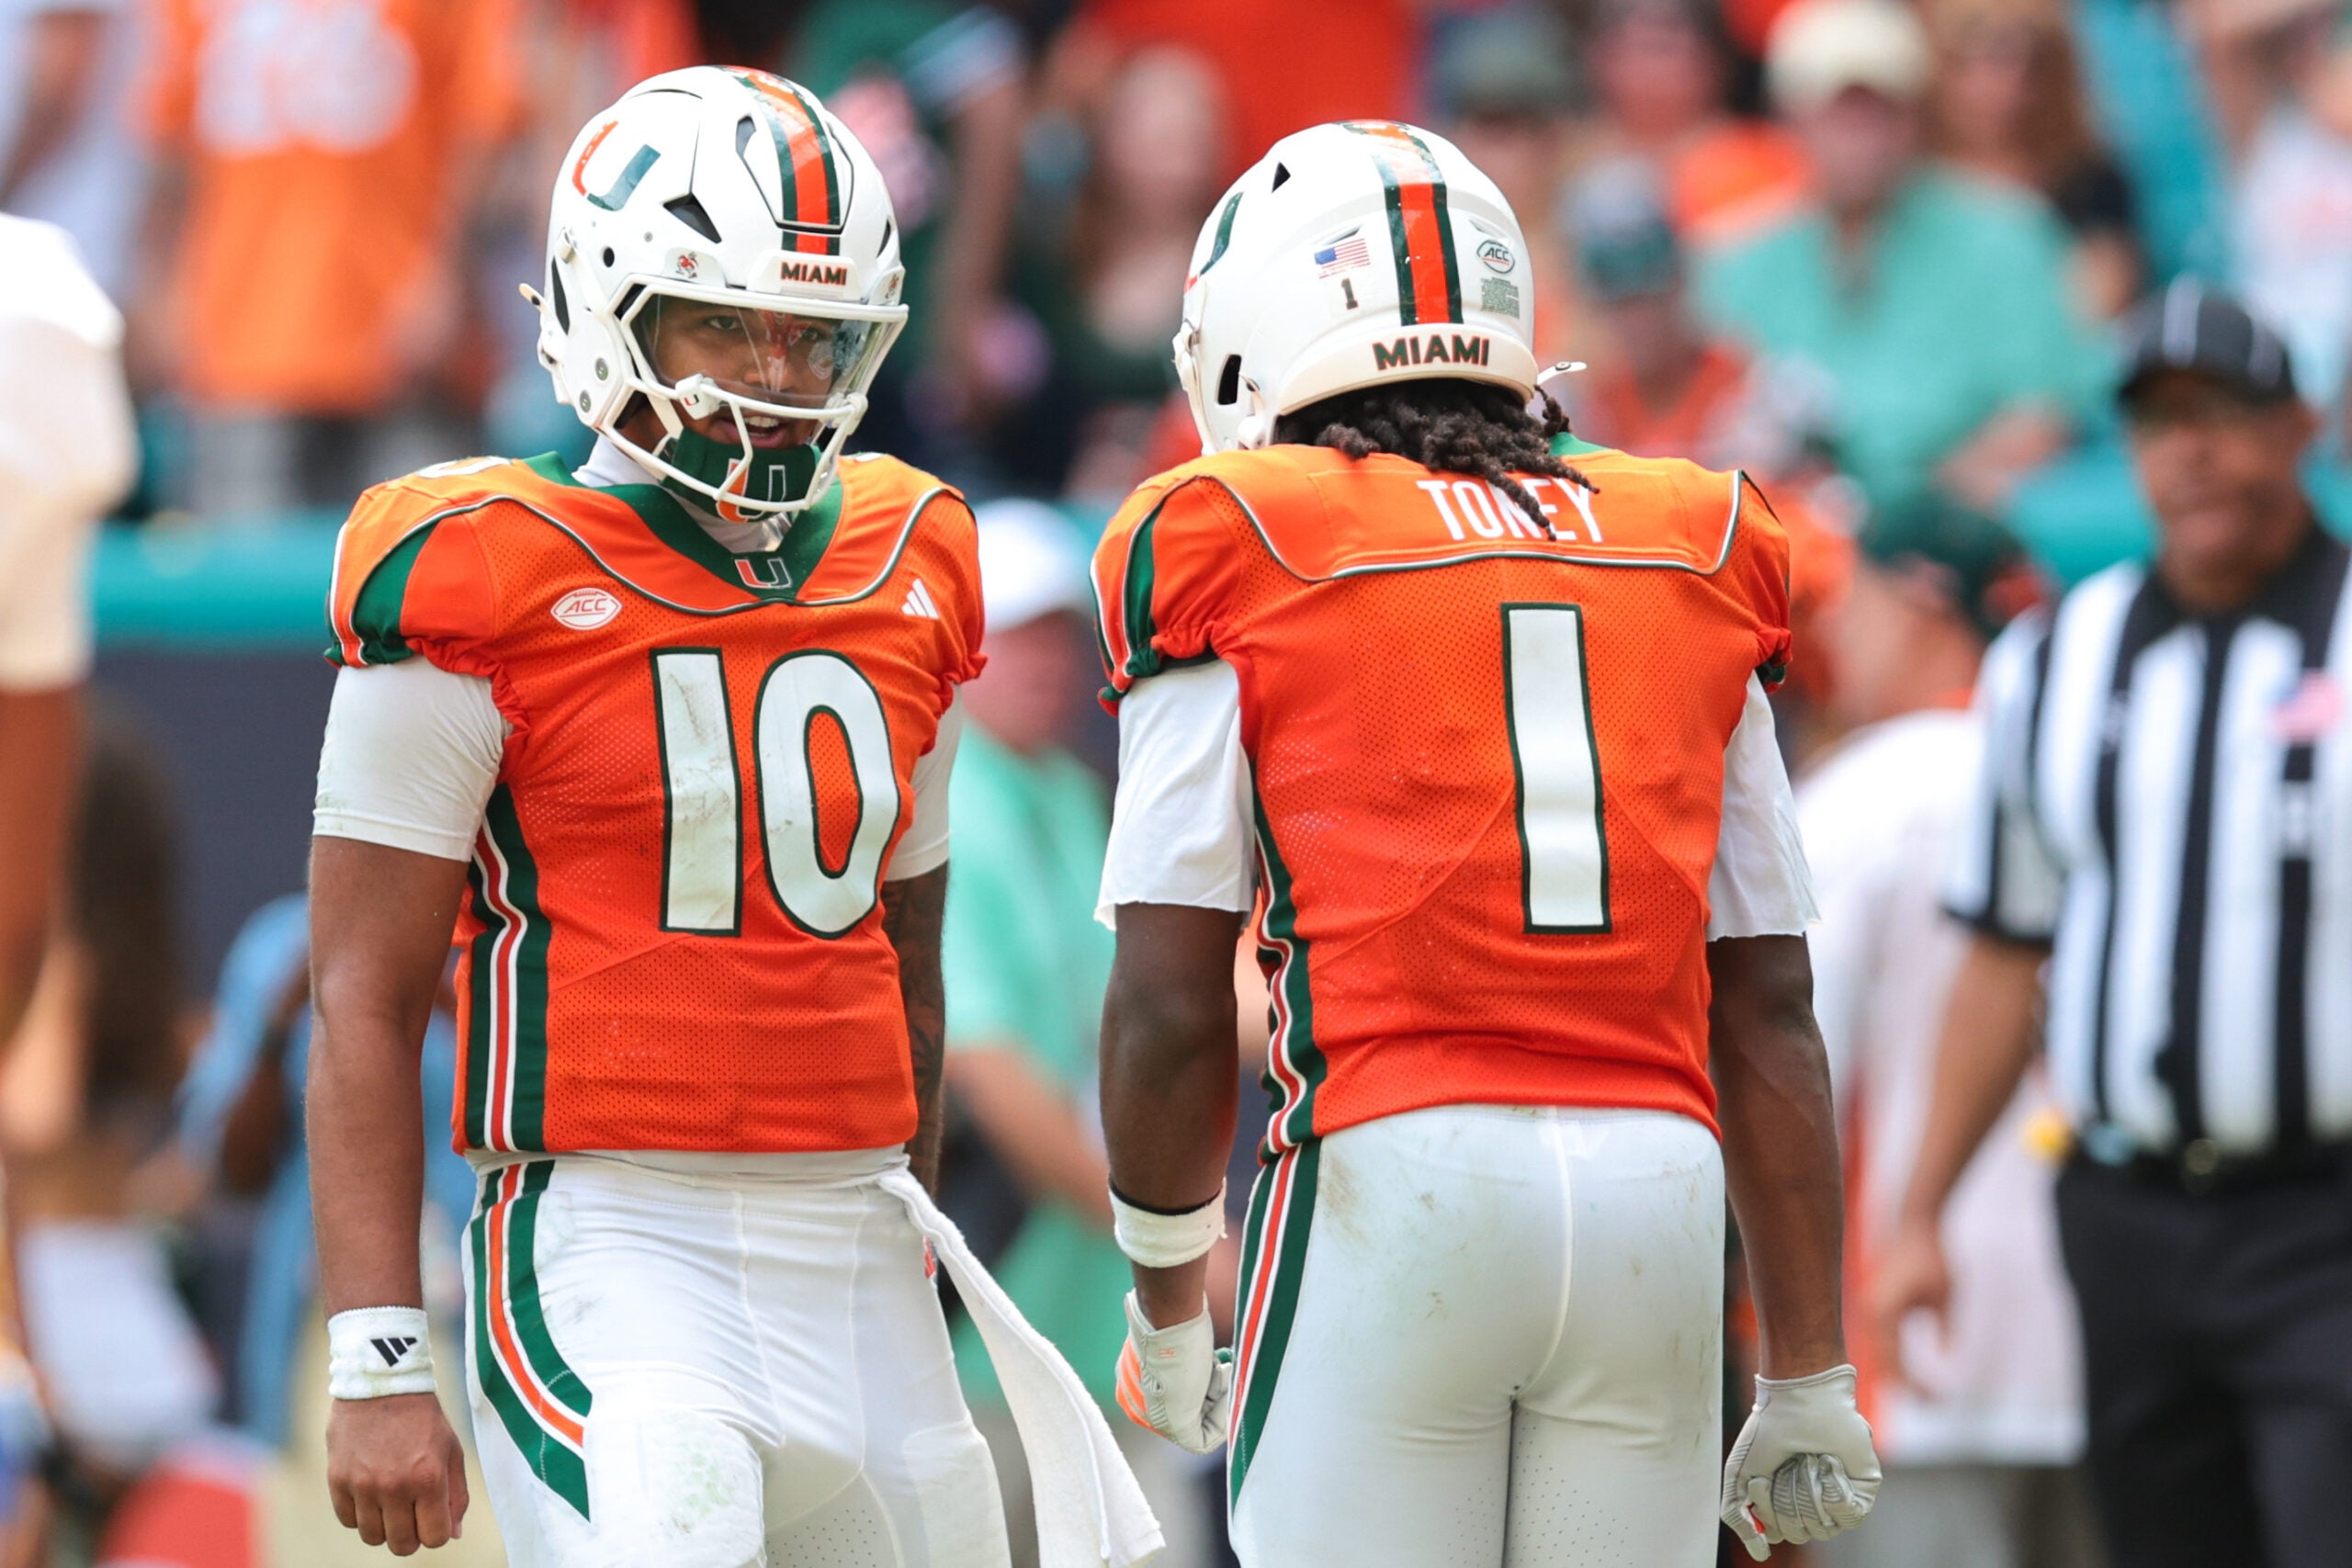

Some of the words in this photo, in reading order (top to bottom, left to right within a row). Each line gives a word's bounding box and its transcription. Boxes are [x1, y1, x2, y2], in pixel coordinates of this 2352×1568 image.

[1484, 247, 1510, 263] ACC
[781, 261, 847, 286] MIAMI
[1341, 277, 1358, 310] 1
[1372, 333, 1490, 371] MIAMI
[1416, 478, 1603, 543] TONEY
[563, 597, 608, 614] ACC
[1500, 602, 1612, 934] 1
[650, 647, 900, 941] 10
